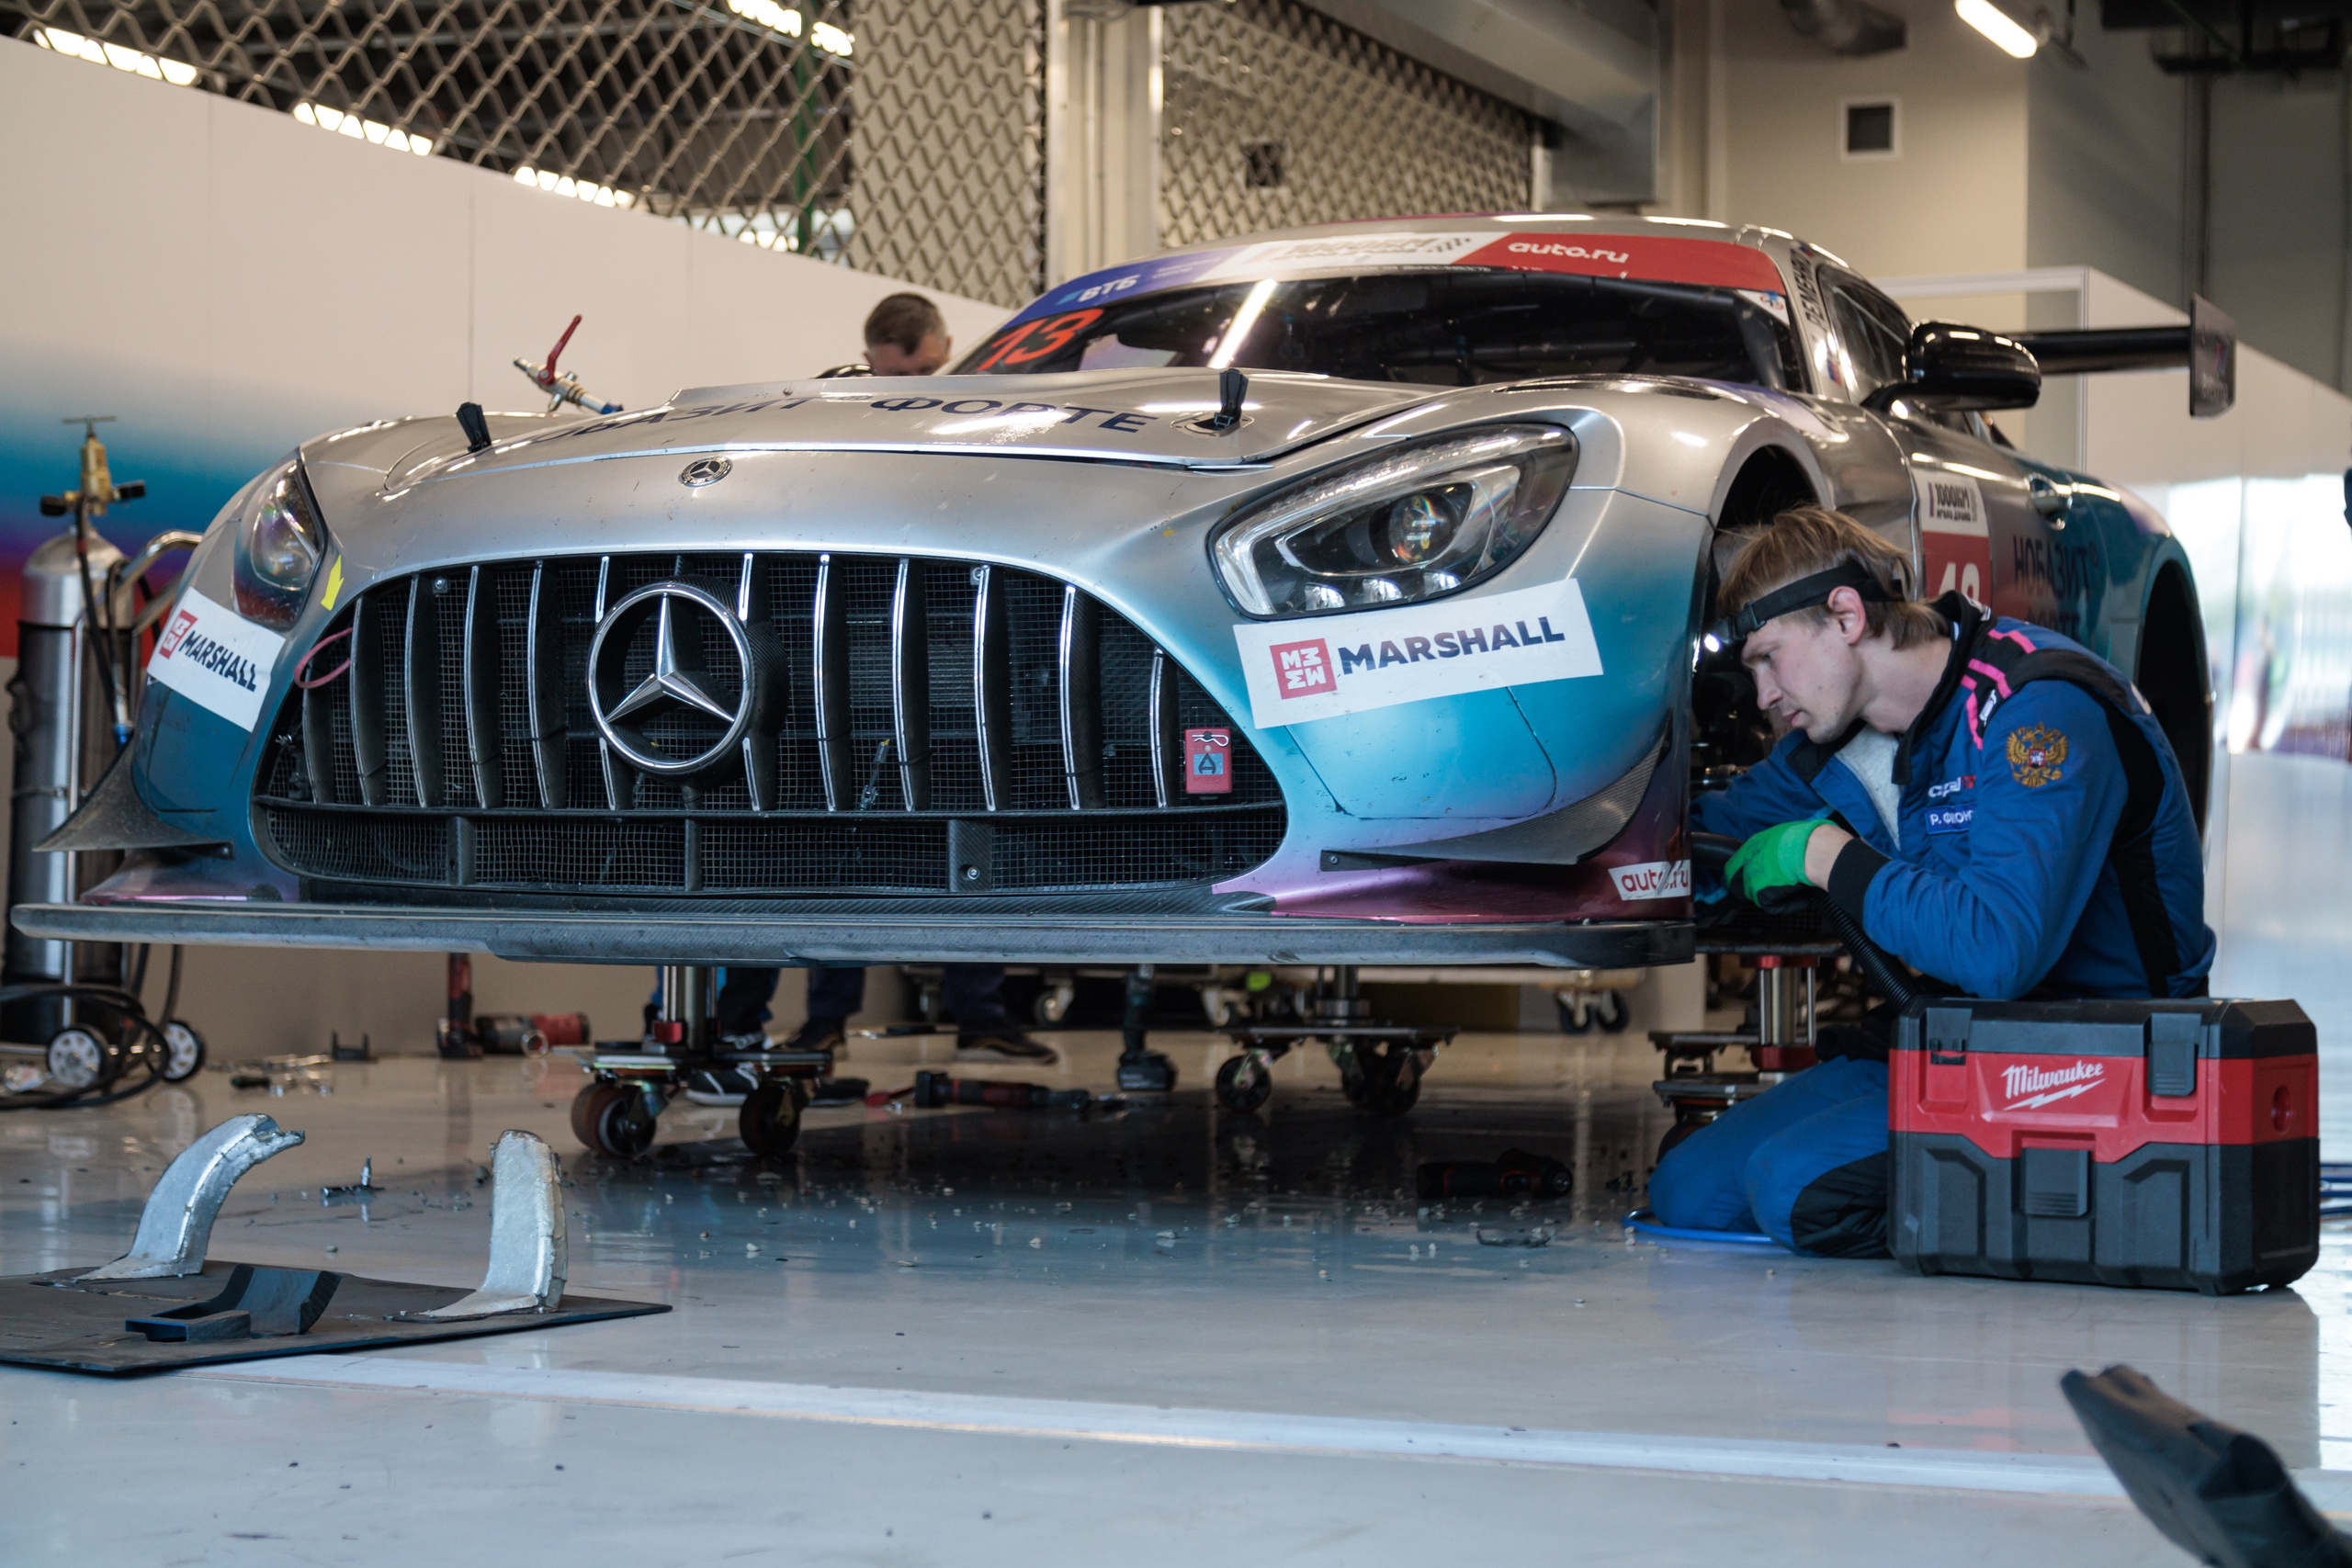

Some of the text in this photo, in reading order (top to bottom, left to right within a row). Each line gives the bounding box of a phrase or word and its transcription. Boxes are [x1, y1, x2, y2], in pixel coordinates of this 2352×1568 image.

[1508, 242, 1630, 264] auto.ru
[1078, 275, 1141, 302] ВТБ
[976, 308, 1104, 371] 13
[870, 396, 1159, 434] ФОРТЕ
[178, 630, 257, 693] MARSHALL
[1338, 616, 1566, 676] MARSHALL
[2001, 1060, 2104, 1100] Milwaukee
